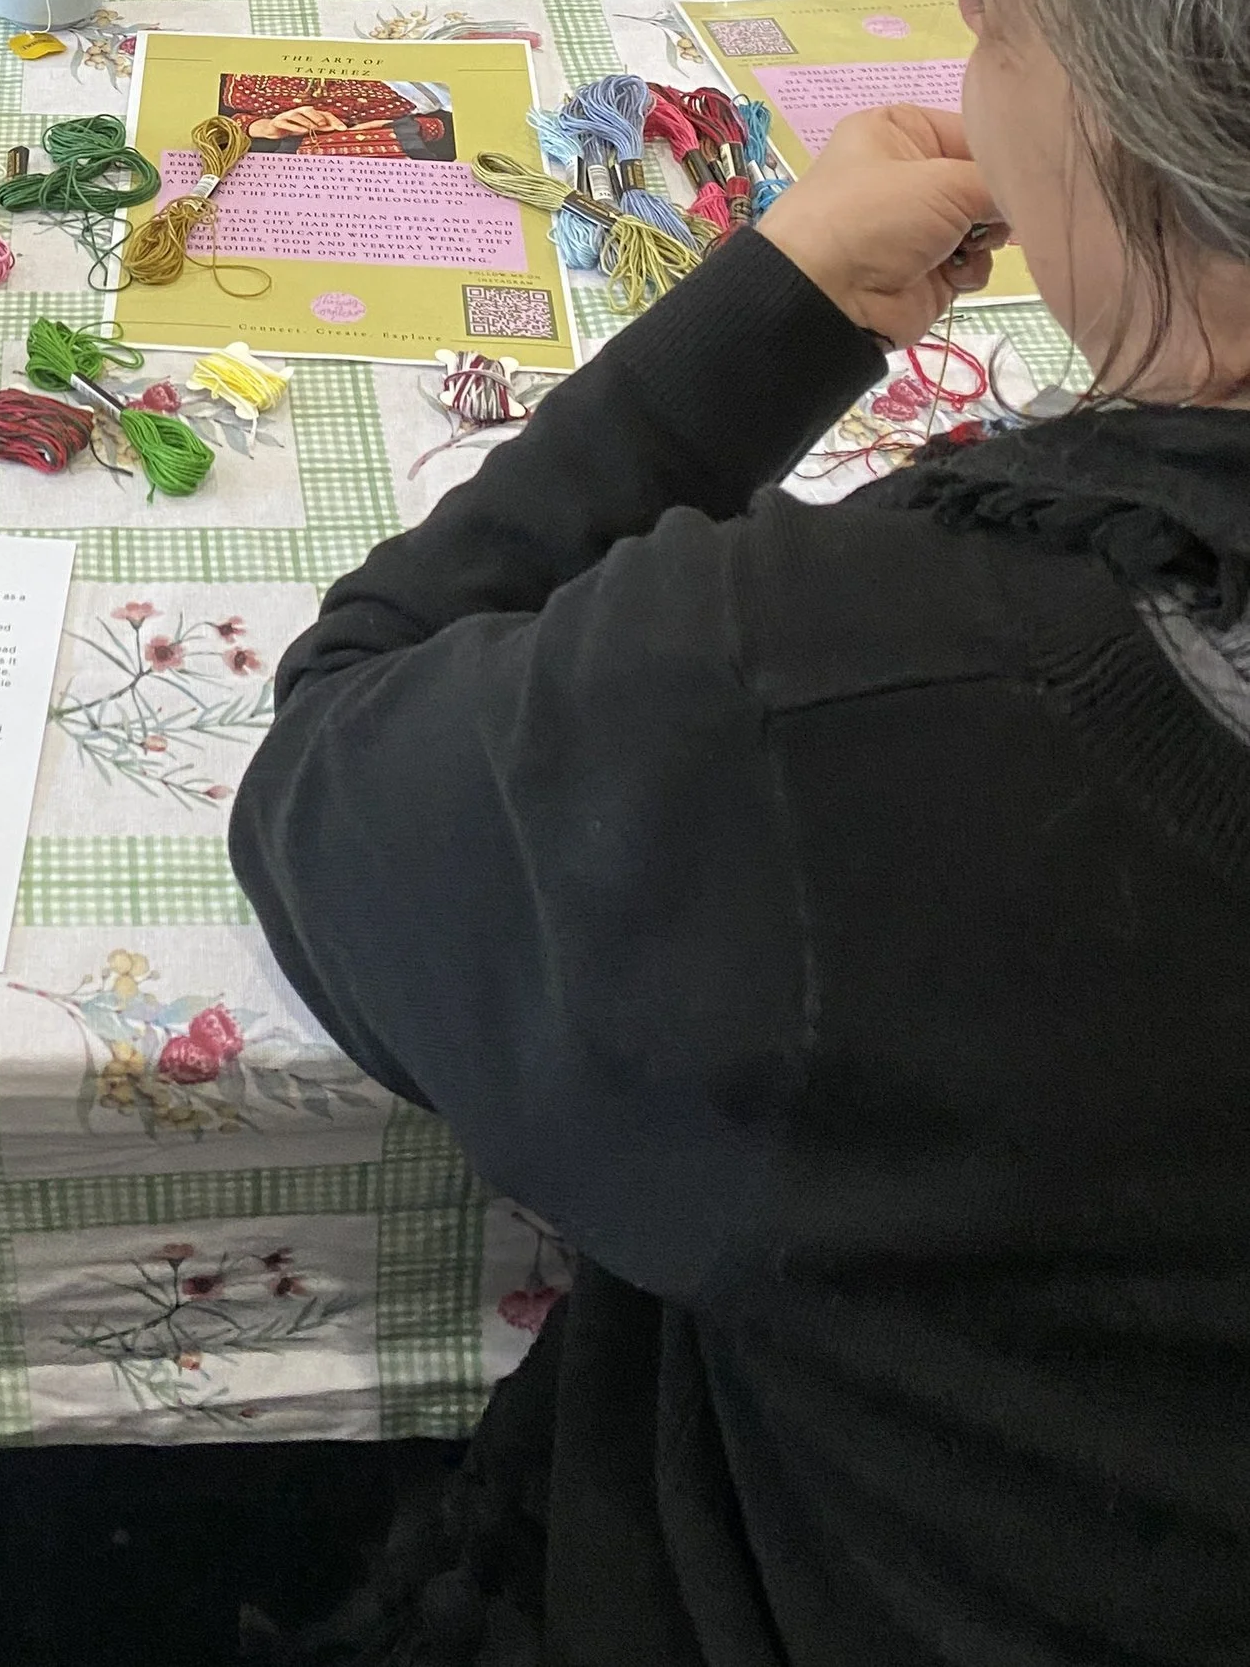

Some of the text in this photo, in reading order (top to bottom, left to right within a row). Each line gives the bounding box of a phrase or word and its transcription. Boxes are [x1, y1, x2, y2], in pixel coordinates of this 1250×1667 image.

[281, 54, 313, 62] THE
[294, 66, 370, 76] TATREEZ
[261, 156, 343, 164] HISTORICAL
[282, 165, 344, 173] IDENTIFY
[350, 168, 435, 178] THEMSELVES
[321, 175, 390, 184] EVERYDAY
[303, 183, 349, 191] ABOUT
[272, 191, 321, 199] PEOPLE
[327, 193, 362, 201] THEY
[367, 195, 439, 204] BELONGED
[296, 211, 387, 220] PALESTINIAN
[335, 222, 402, 230] DISTINCT
[407, 225, 478, 234] FEATURES
[483, 228, 512, 236] AND
[264, 228, 341, 237] INDICATED
[385, 233, 420, 241] THEY
[475, 237, 512, 245] THEY
[273, 237, 310, 245] FOOD
[352, 241, 423, 250] EVERYDAY
[317, 249, 356, 257] ONTO
[363, 251, 406, 259] THEIR
